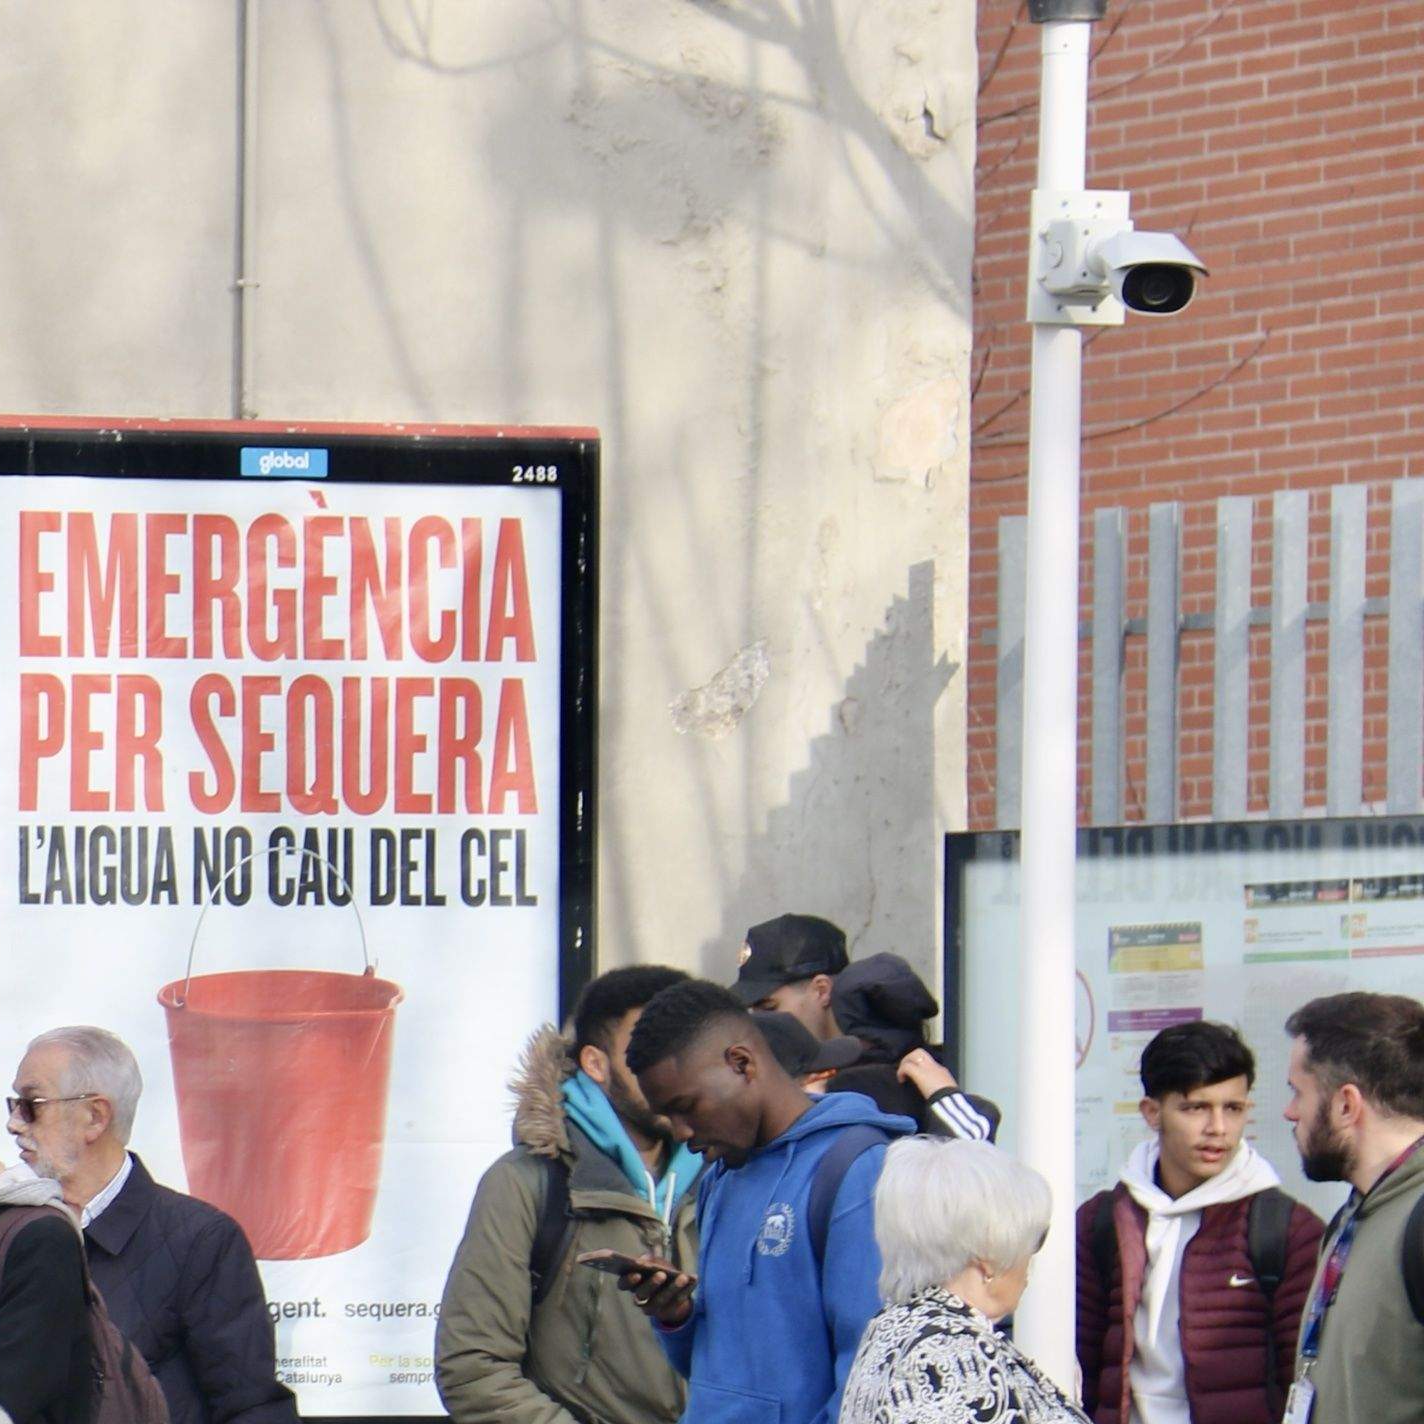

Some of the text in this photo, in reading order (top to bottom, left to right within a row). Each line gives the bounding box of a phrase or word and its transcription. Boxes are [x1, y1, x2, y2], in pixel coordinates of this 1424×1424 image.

[259, 451, 309, 474] global
[512, 465, 558, 482] 2488
[18, 490, 539, 663] EMERGÈNCIA
[18, 672, 539, 816] PER SEQUERA
[18, 825, 539, 908] L'AIGUA NO CAU DEL CEL
[267, 1297, 327, 1324] gent.
[344, 1302, 442, 1322] sequera.g
[390, 1372, 433, 1385] sempr
